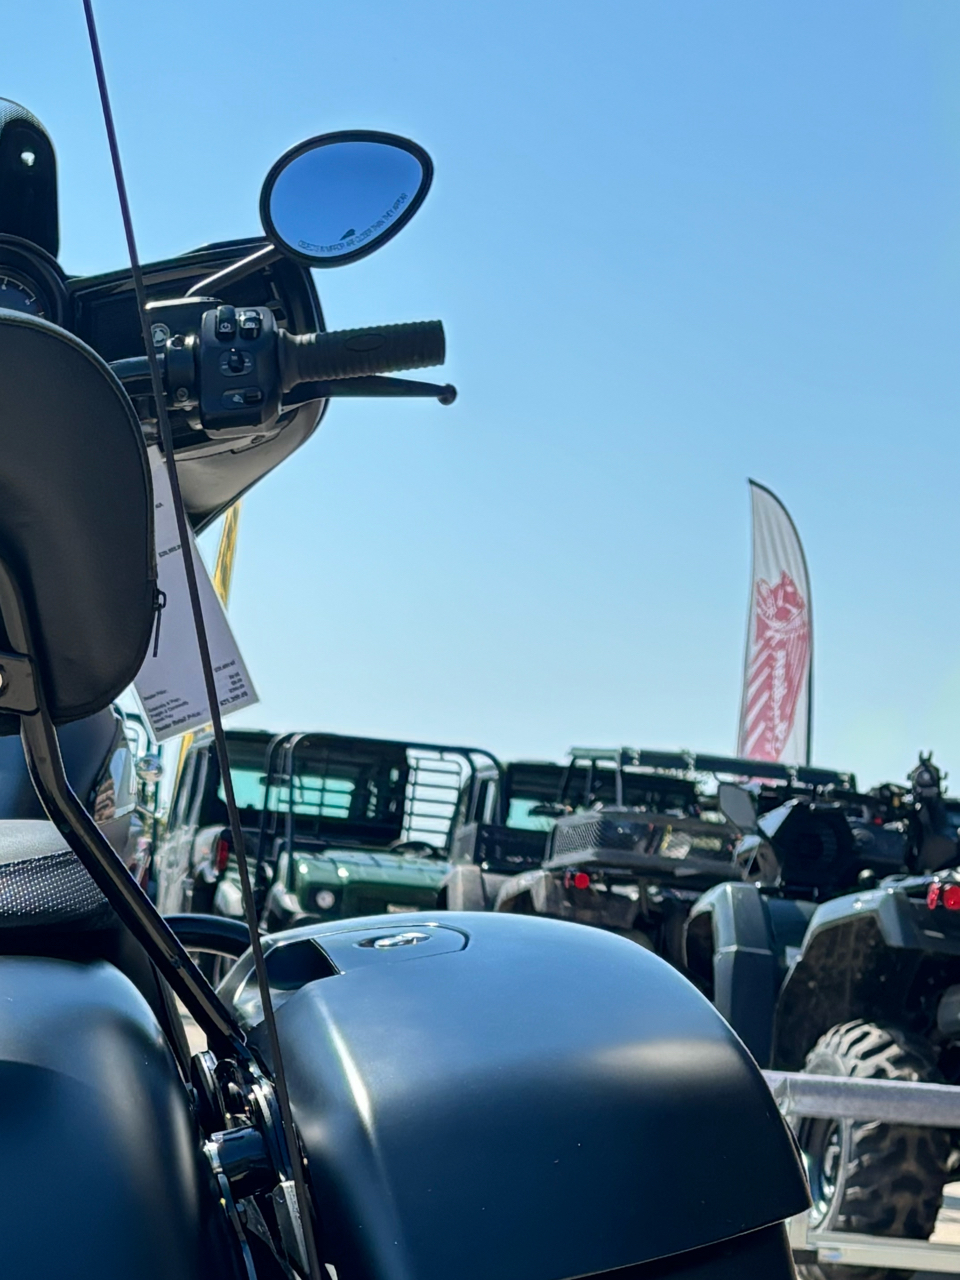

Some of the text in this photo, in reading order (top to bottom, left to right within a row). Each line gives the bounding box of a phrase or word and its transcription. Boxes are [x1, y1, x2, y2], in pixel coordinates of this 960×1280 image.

[355, 228, 373, 243] CLOSER
[382, 208, 395, 221] THEY
[392, 192, 408, 211] APPEAR
